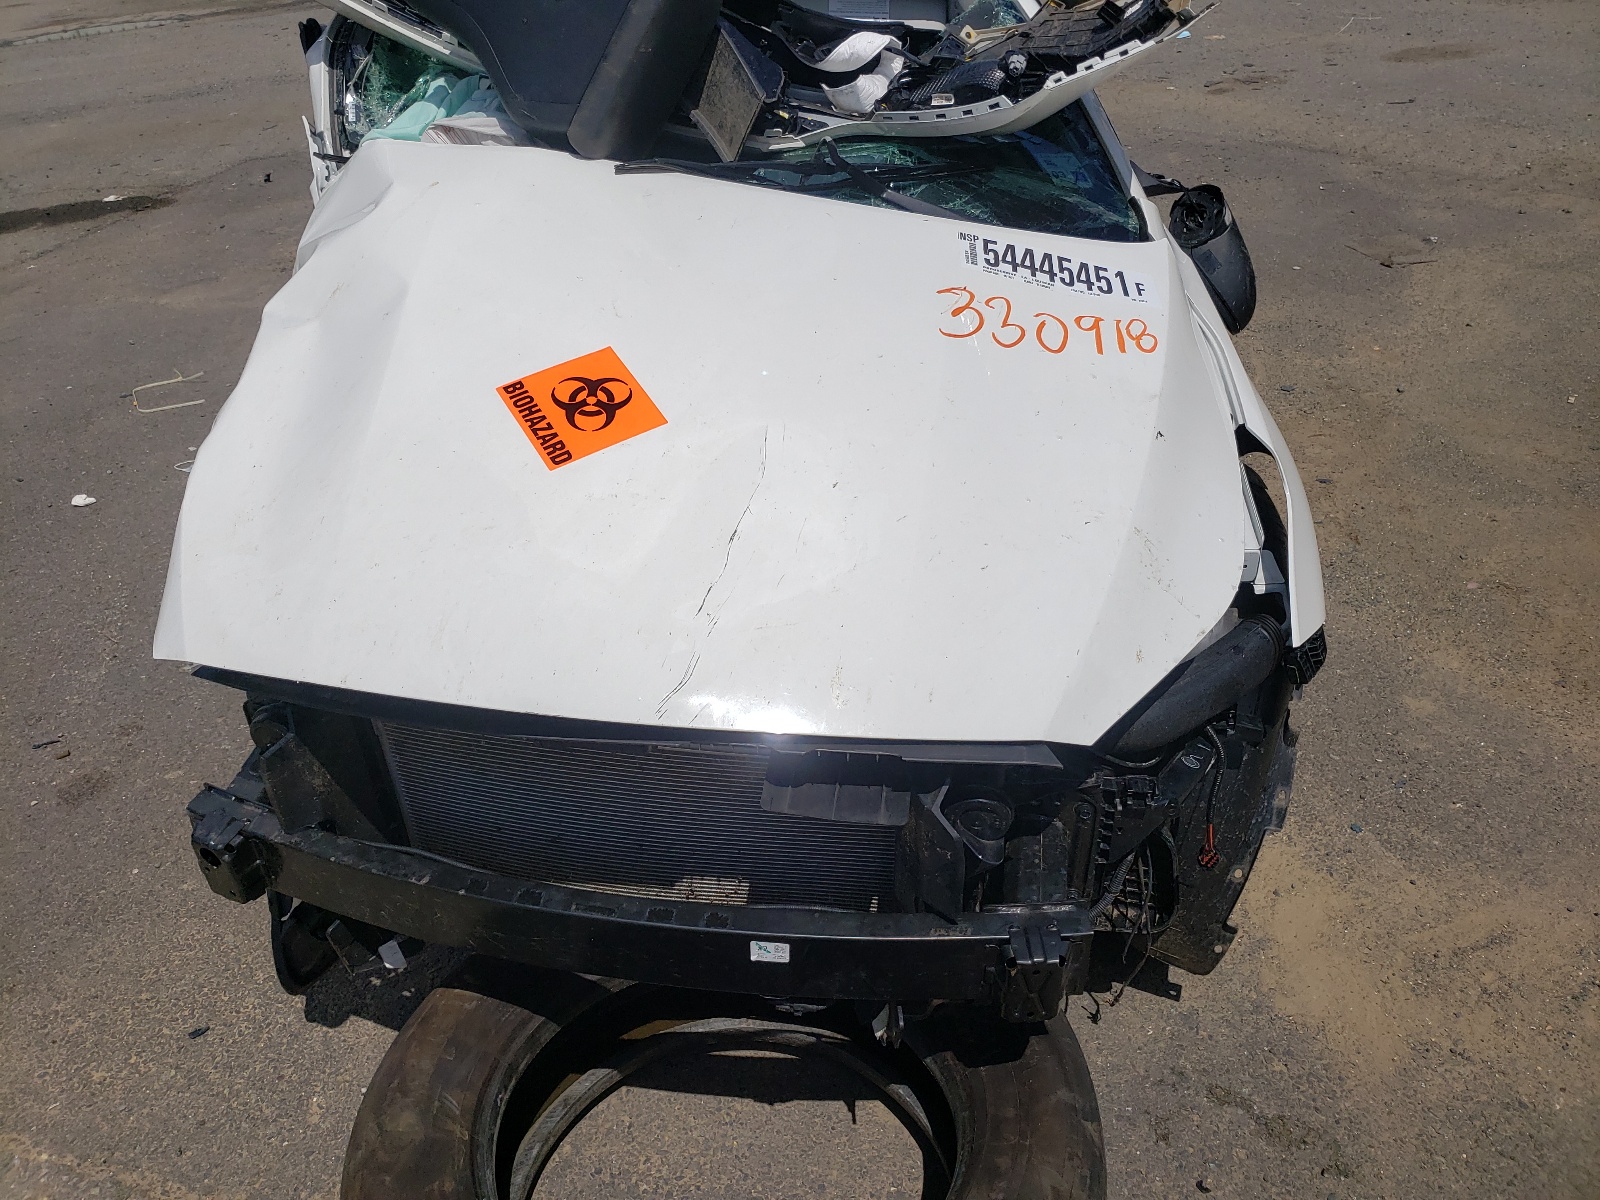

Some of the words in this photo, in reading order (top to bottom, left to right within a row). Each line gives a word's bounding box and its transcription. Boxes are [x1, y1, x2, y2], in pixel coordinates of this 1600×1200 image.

[982, 239, 1129, 297] 54445451
[1135, 282, 1146, 297] F
[936, 287, 1158, 355] 330918
[503, 381, 572, 465] BIOHAZARD
